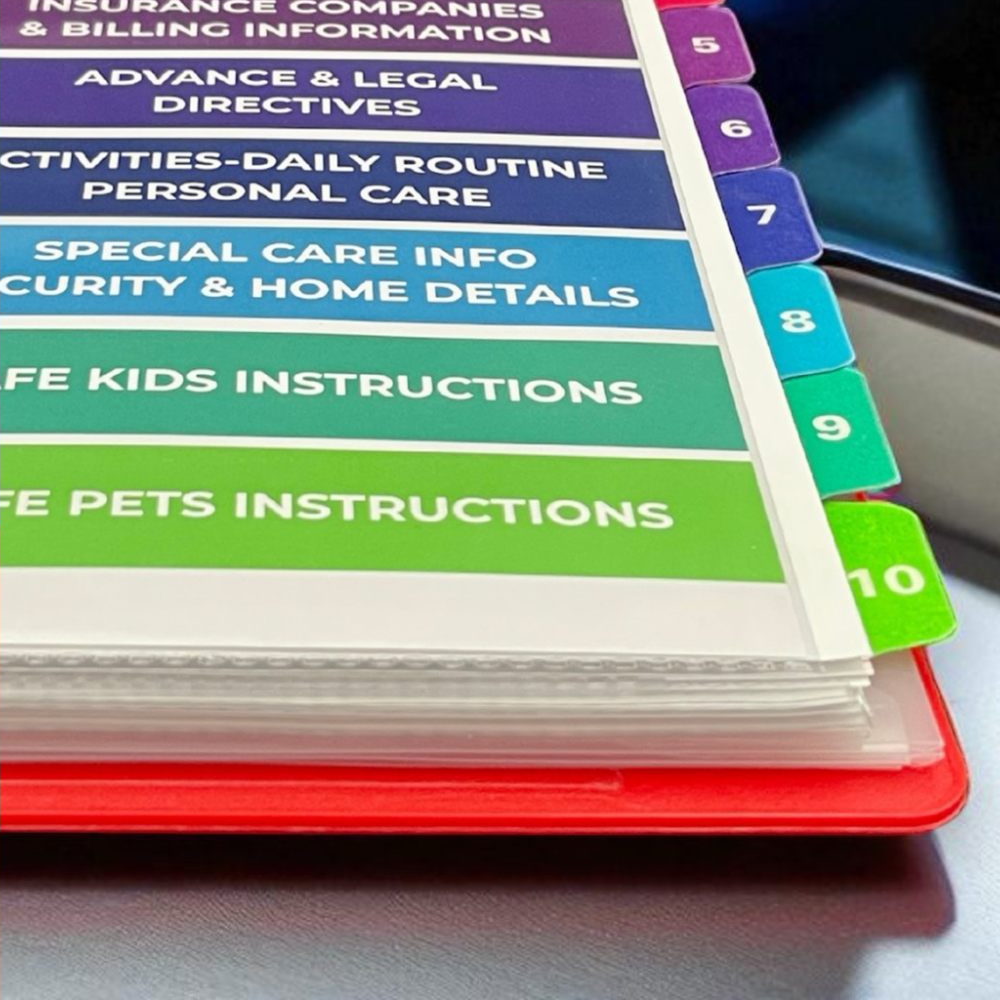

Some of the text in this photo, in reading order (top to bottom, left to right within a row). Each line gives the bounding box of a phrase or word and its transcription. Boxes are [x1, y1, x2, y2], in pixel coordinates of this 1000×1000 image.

[18, 20, 551, 44] & BILLING INFORMATION
[691, 36, 721, 54] 5
[74, 69, 498, 91] ADVANCE & LEGAL
[153, 96, 421, 117] DIRECTIVES
[721, 120, 751, 137] 6
[395, 156, 607, 179] ROUTINE
[83, 182, 491, 206] PERSONAL CARE
[747, 205, 776, 224] 7
[34, 241, 536, 269] SPECIAL CARE INFO
[0, 275, 639, 307] CURITY & HOME DETAILS
[780, 310, 815, 333] 8
[0, 367, 642, 404] FE KIDS INSTRUCTIONS
[812, 415, 851, 441] 9
[70, 490, 215, 517] PETS
[236, 492, 673, 529] INSTRUCTIONS
[847, 564, 926, 598] 10
